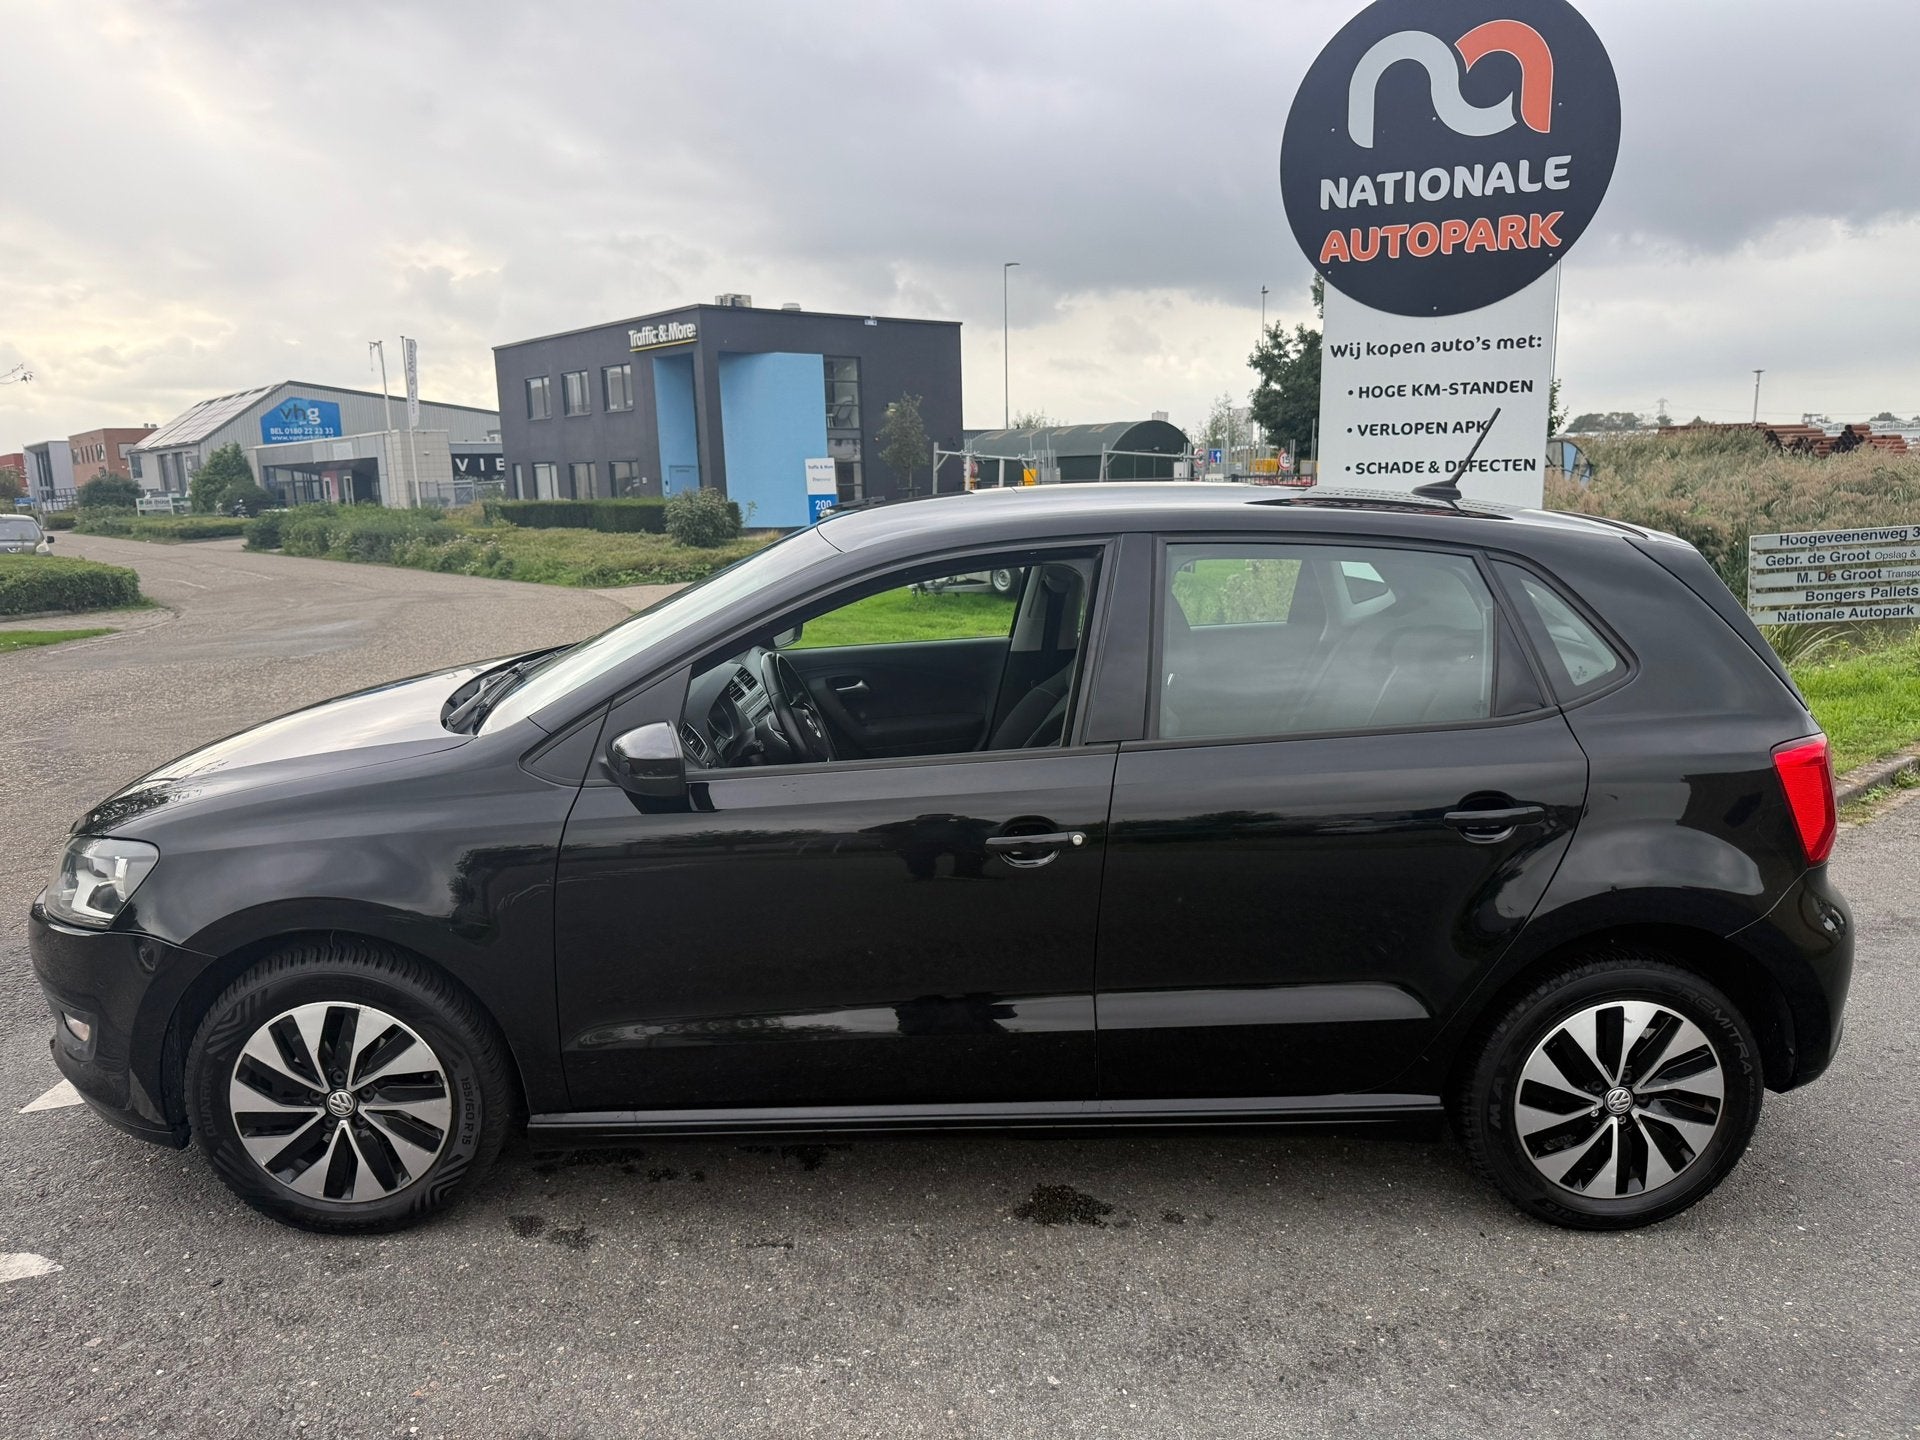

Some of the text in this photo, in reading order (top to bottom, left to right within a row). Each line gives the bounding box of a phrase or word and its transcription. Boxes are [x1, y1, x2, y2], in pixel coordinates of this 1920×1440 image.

[1320, 155, 1572, 210] NATIONALE
[1319, 211, 1564, 264] AUTOPARK
[628, 322, 696, 347] Traffic & More
[1330, 334, 1542, 360] Wij kopen auto's met:
[1358, 379, 1533, 399] HOGE KM-STANDEN
[280, 404, 321, 425] vhg
[270, 427, 284, 435] BEL
[1358, 420, 1489, 436] VERLOPEN APK
[455, 458, 504, 471] VIE
[1355, 460, 1425, 475] SCHADE
[1428, 459, 1440, 473] &
[815, 500, 832, 510] 200
[1780, 529, 1908, 547] Hoogeveenenweg
[1765, 550, 1916, 567] Gebr. de Groot Opslag &
[1796, 572, 1813, 583] M.
[1818, 570, 1837, 582] De
[1841, 568, 1882, 580] Groot
[1805, 585, 1919, 603] Bongers Pallets
[1777, 604, 1915, 623] Nationale Autopark
